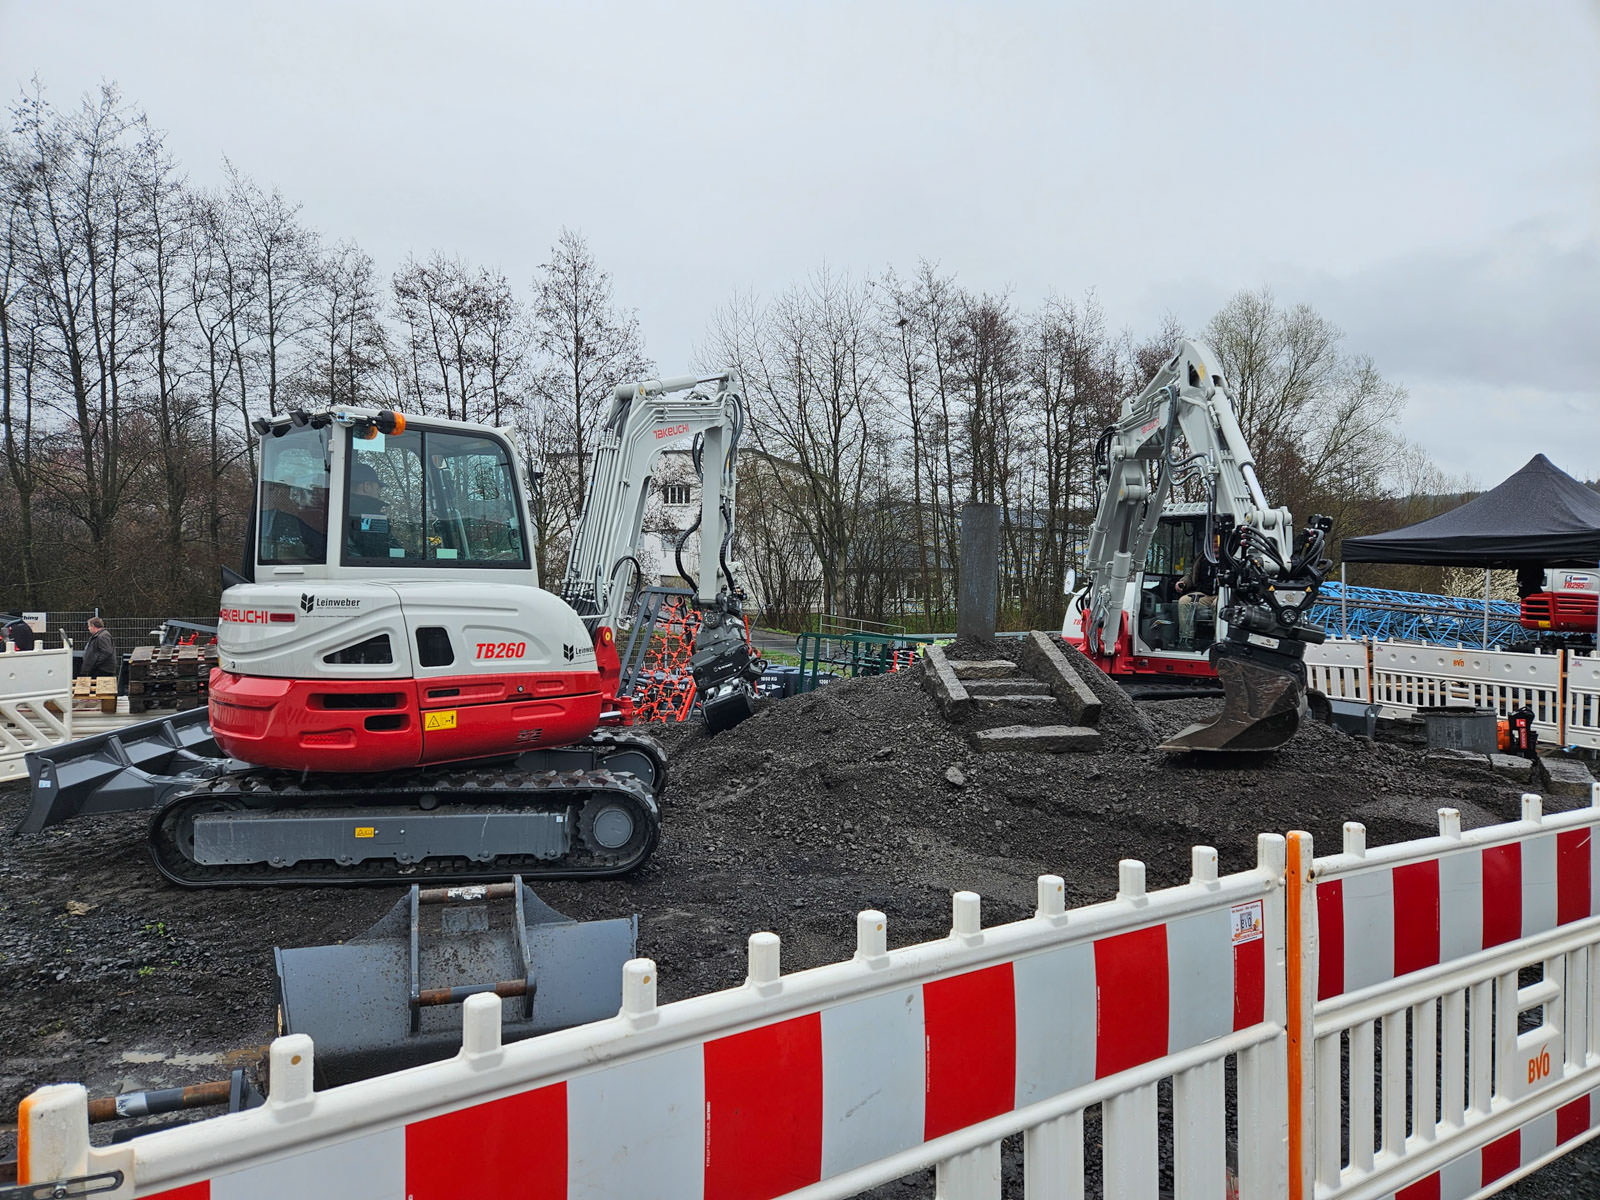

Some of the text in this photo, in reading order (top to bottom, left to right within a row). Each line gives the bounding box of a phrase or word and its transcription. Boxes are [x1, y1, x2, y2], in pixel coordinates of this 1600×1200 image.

[653, 423, 689, 439] TAKEUCHI
[316, 597, 361, 606] Leinweber
[476, 642, 526, 659] TB260
[1528, 1042, 1550, 1084] BVO
